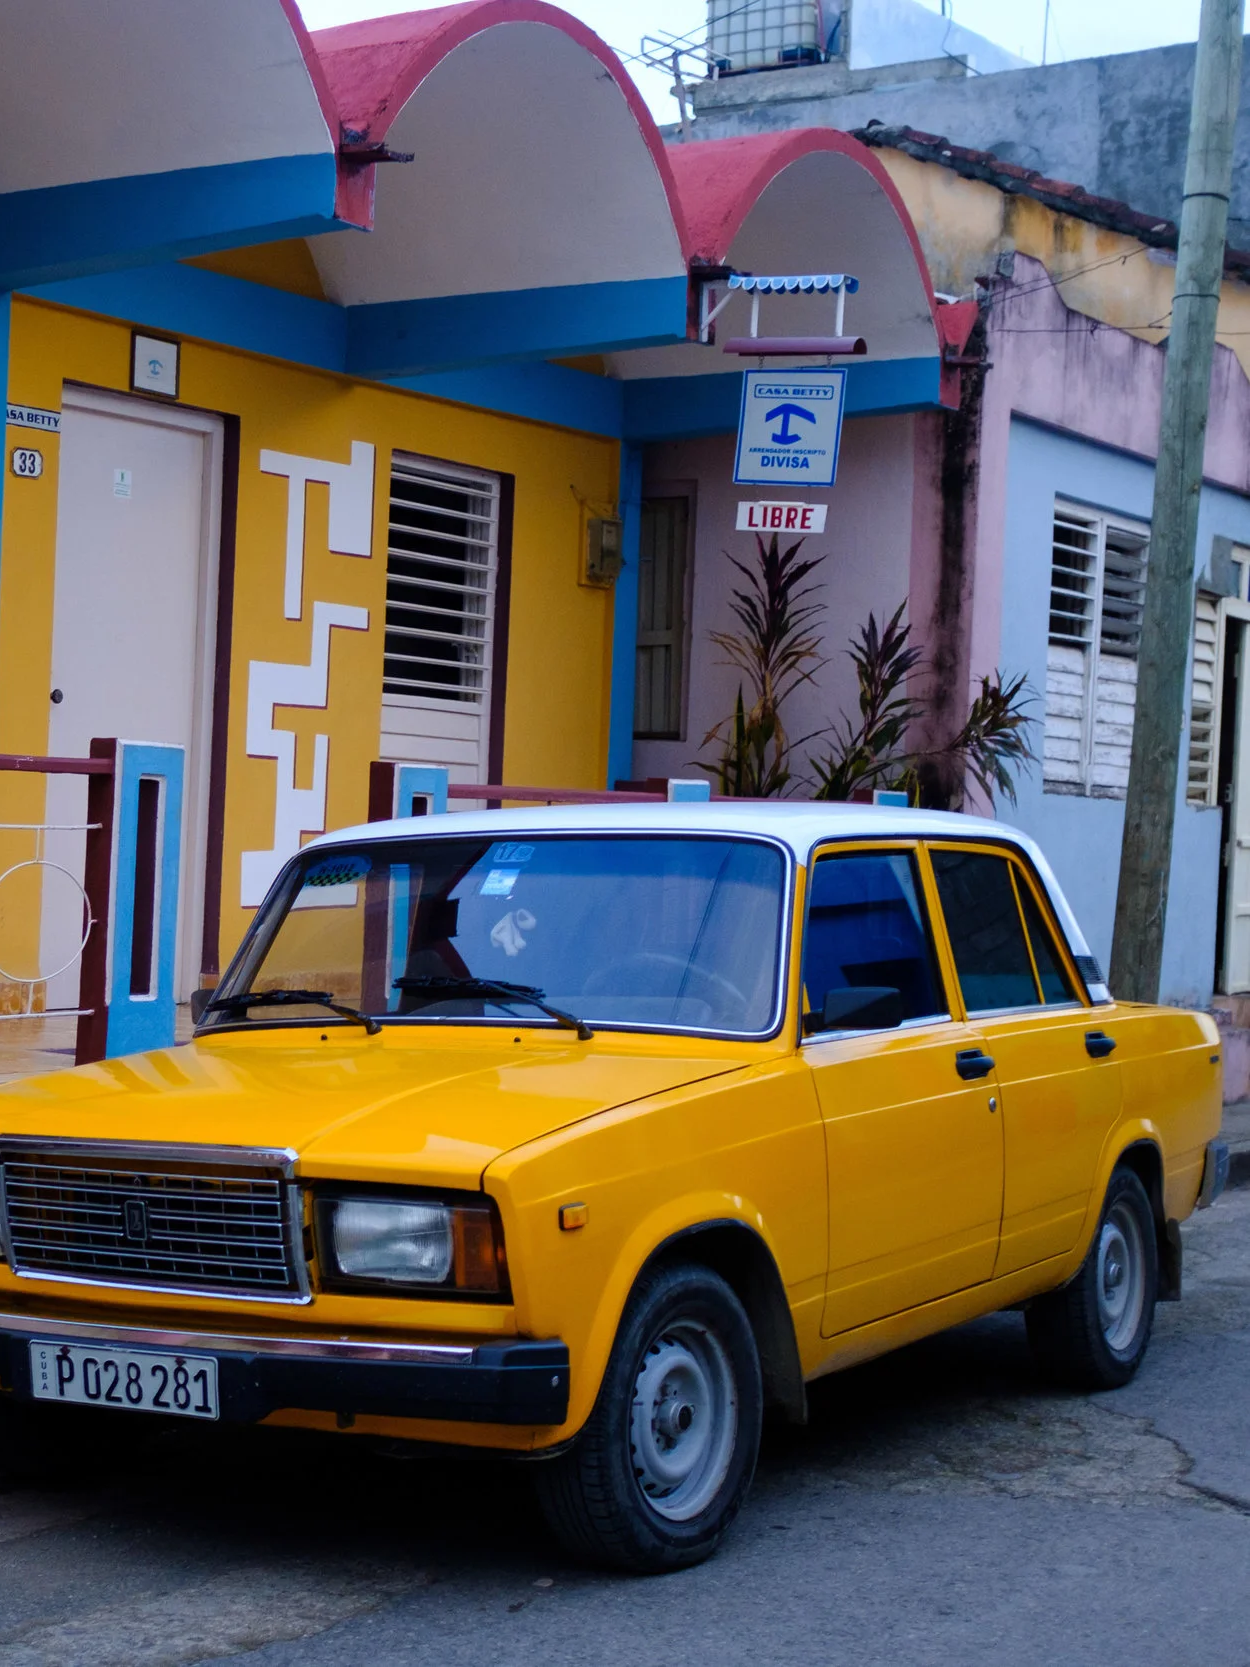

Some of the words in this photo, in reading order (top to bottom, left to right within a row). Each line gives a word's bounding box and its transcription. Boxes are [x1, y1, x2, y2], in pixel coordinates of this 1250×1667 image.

[758, 387, 789, 395] CASA
[792, 388, 830, 396] BETTY
[27, 412, 60, 427] BETTY
[19, 452, 36, 474] 33
[760, 455, 810, 469] DIVISA
[747, 506, 814, 530] LIBRE
[40, 1351, 49, 1391] CUBA
